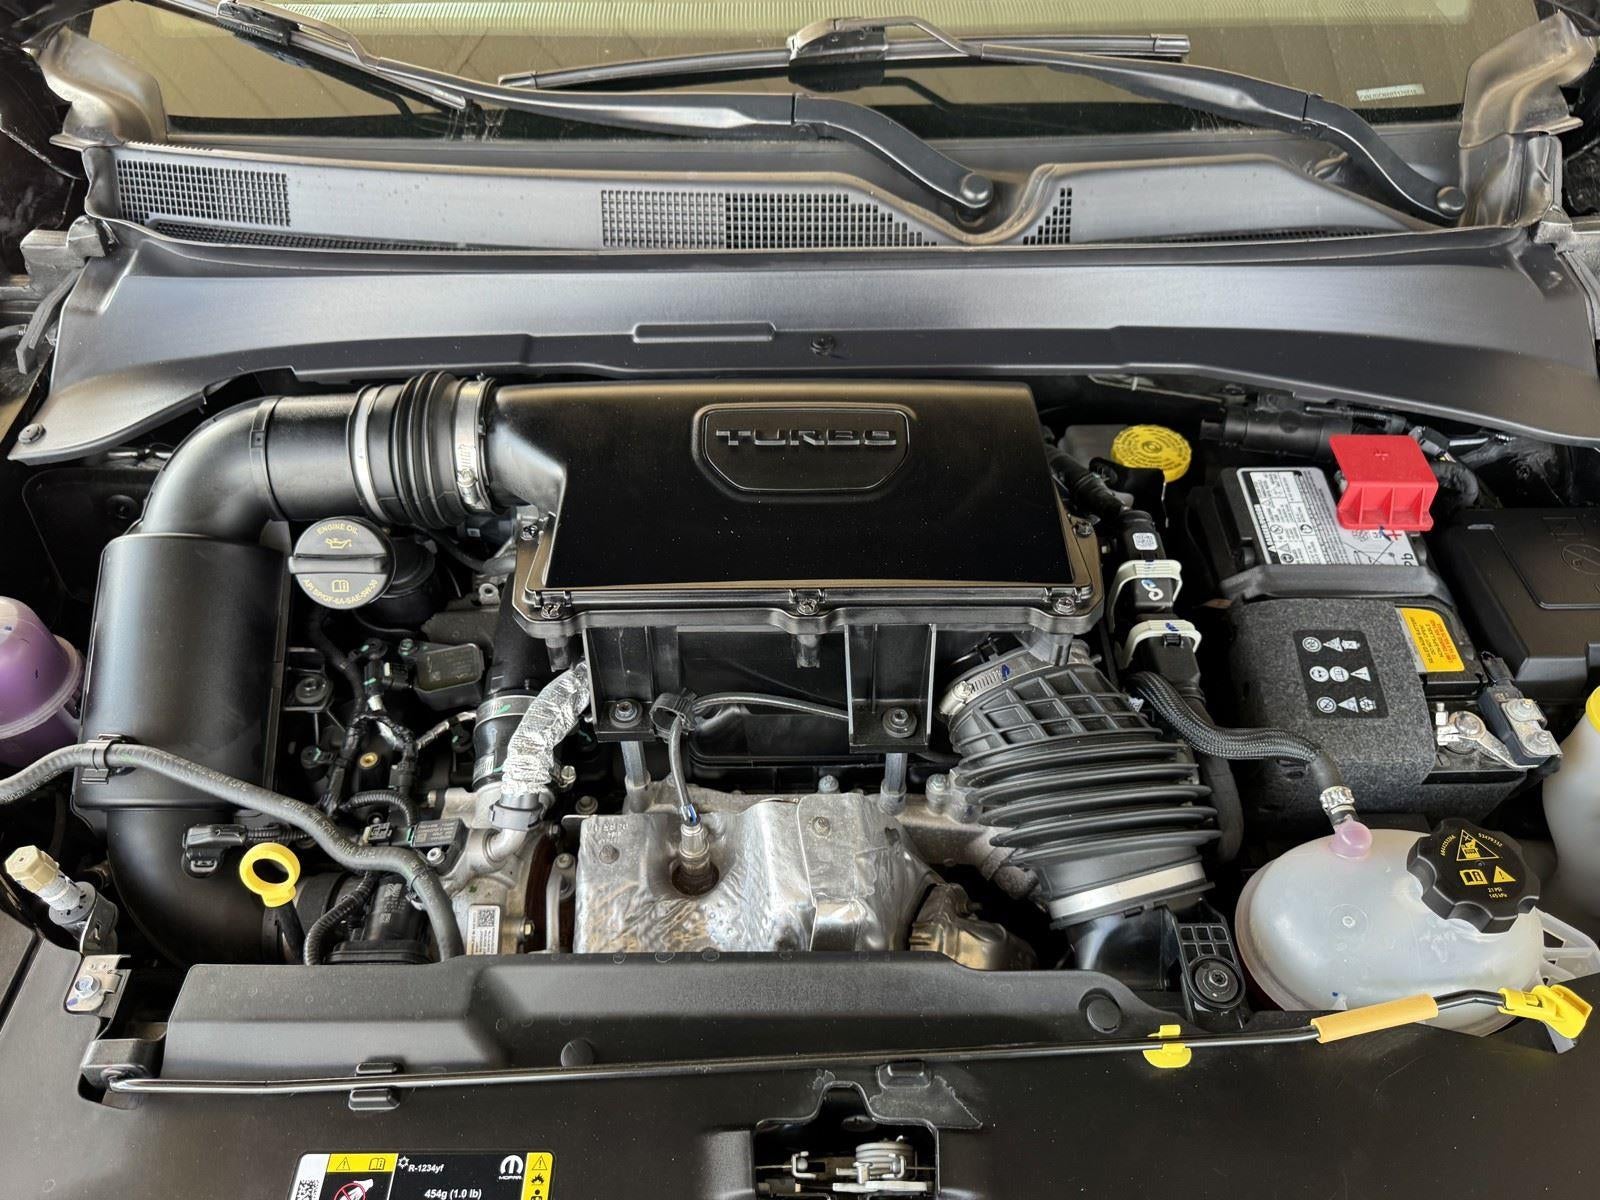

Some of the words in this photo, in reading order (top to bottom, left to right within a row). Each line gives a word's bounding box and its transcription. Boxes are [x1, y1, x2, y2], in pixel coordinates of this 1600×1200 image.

[715, 429, 897, 446] TURBO
[316, 523, 345, 536] ENGINE
[346, 525, 358, 535] OIL
[408, 1163, 445, 1174] R-1234yf
[424, 1188, 448, 1200] 454g
[449, 1188, 468, 1200] (1.0
[469, 1188, 482, 1200] lb)
